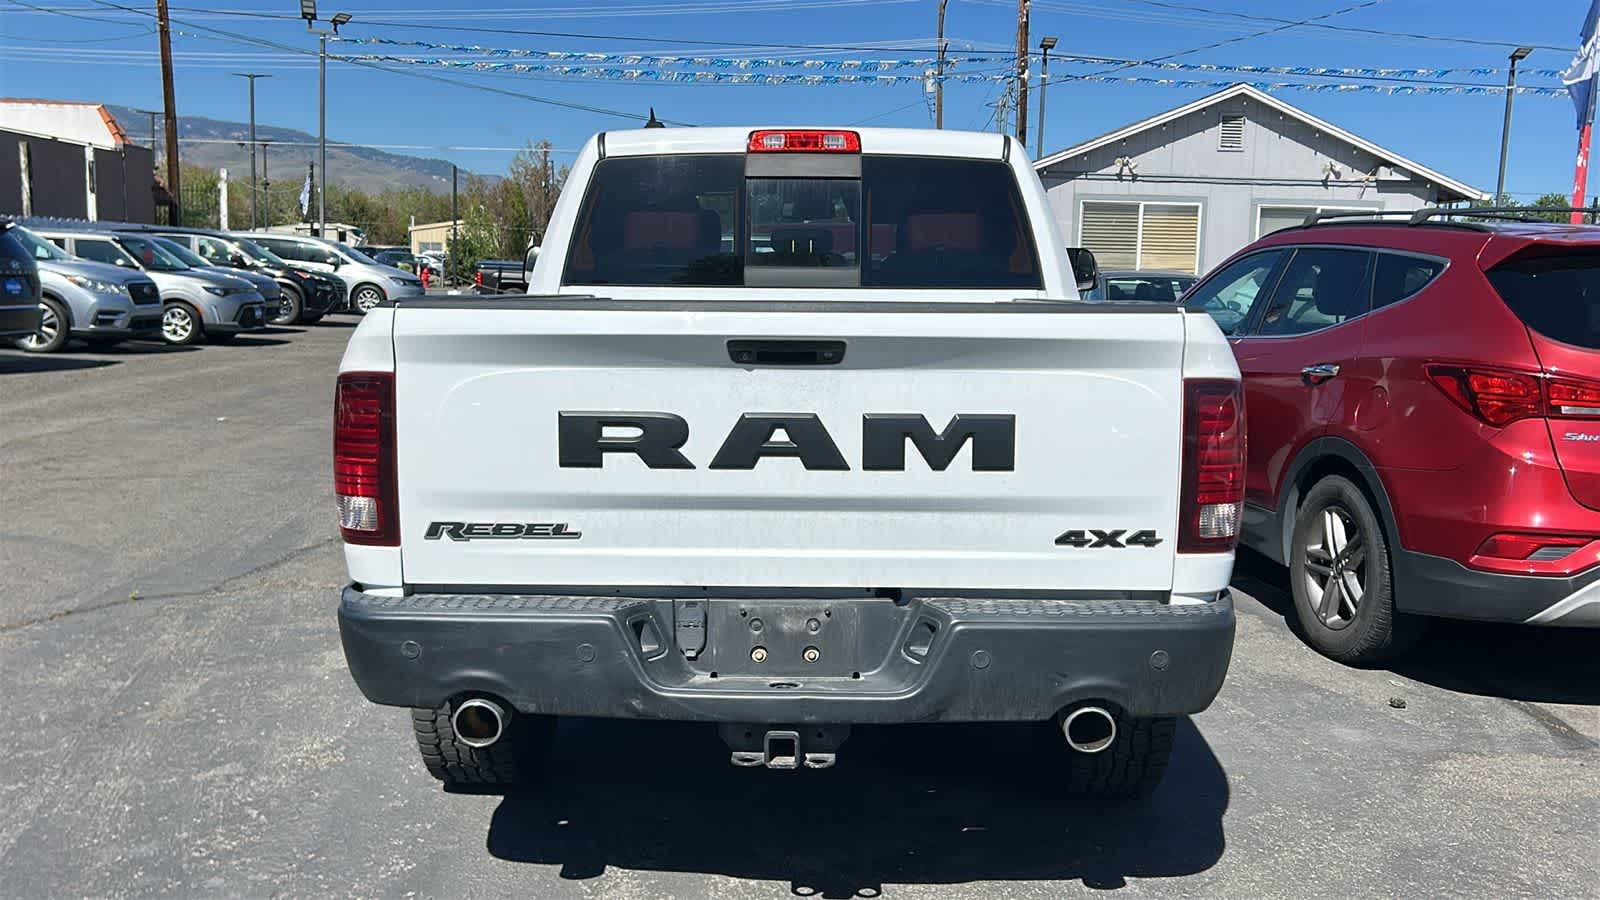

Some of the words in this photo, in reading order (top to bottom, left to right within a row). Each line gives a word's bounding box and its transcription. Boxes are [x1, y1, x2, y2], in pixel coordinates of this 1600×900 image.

[558, 410, 1016, 471] RAM
[424, 521, 582, 542] REBEL
[1054, 529, 1164, 548] 4X4
